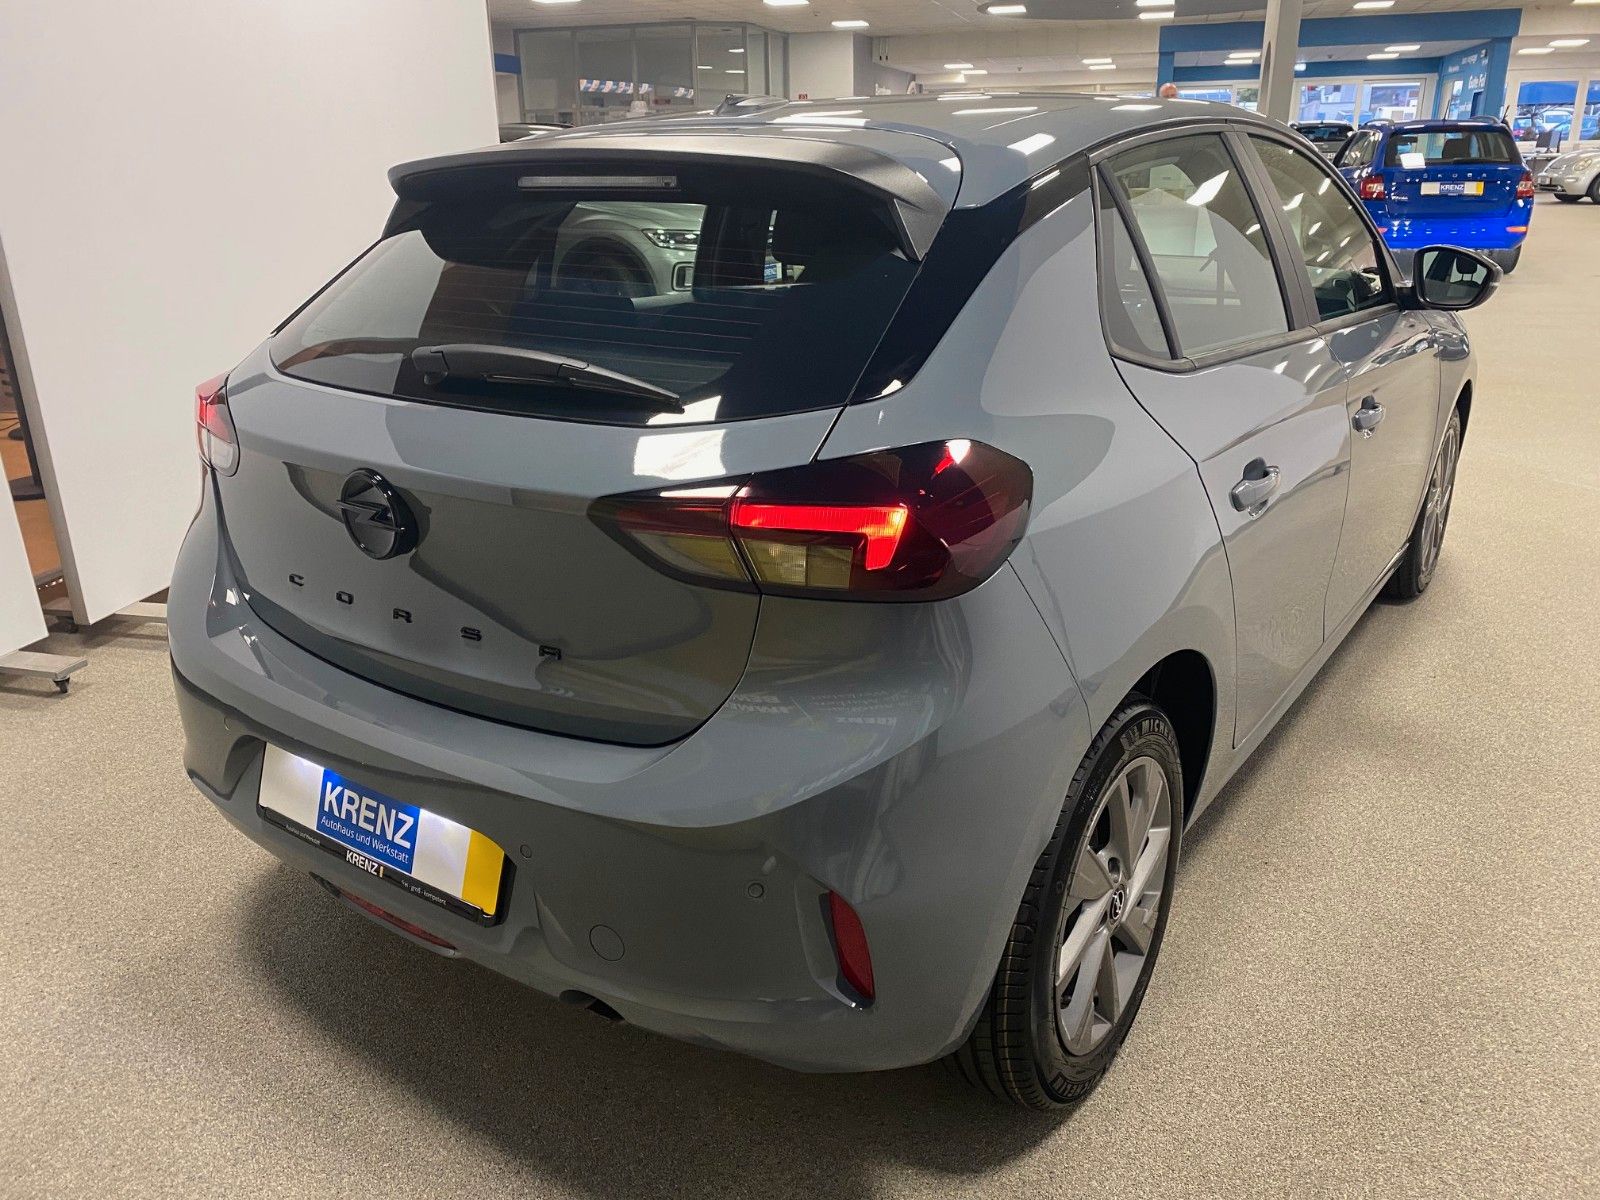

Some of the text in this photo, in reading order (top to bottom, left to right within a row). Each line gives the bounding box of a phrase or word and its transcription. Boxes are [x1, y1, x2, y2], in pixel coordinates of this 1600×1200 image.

[288, 572, 562, 661] CORSA
[321, 815, 355, 838] Autohaus
[355, 833, 371, 846] und
[371, 838, 408, 863] Werkstatt
[323, 781, 414, 849] KRENZ
[345, 849, 379, 876] KRENZ
